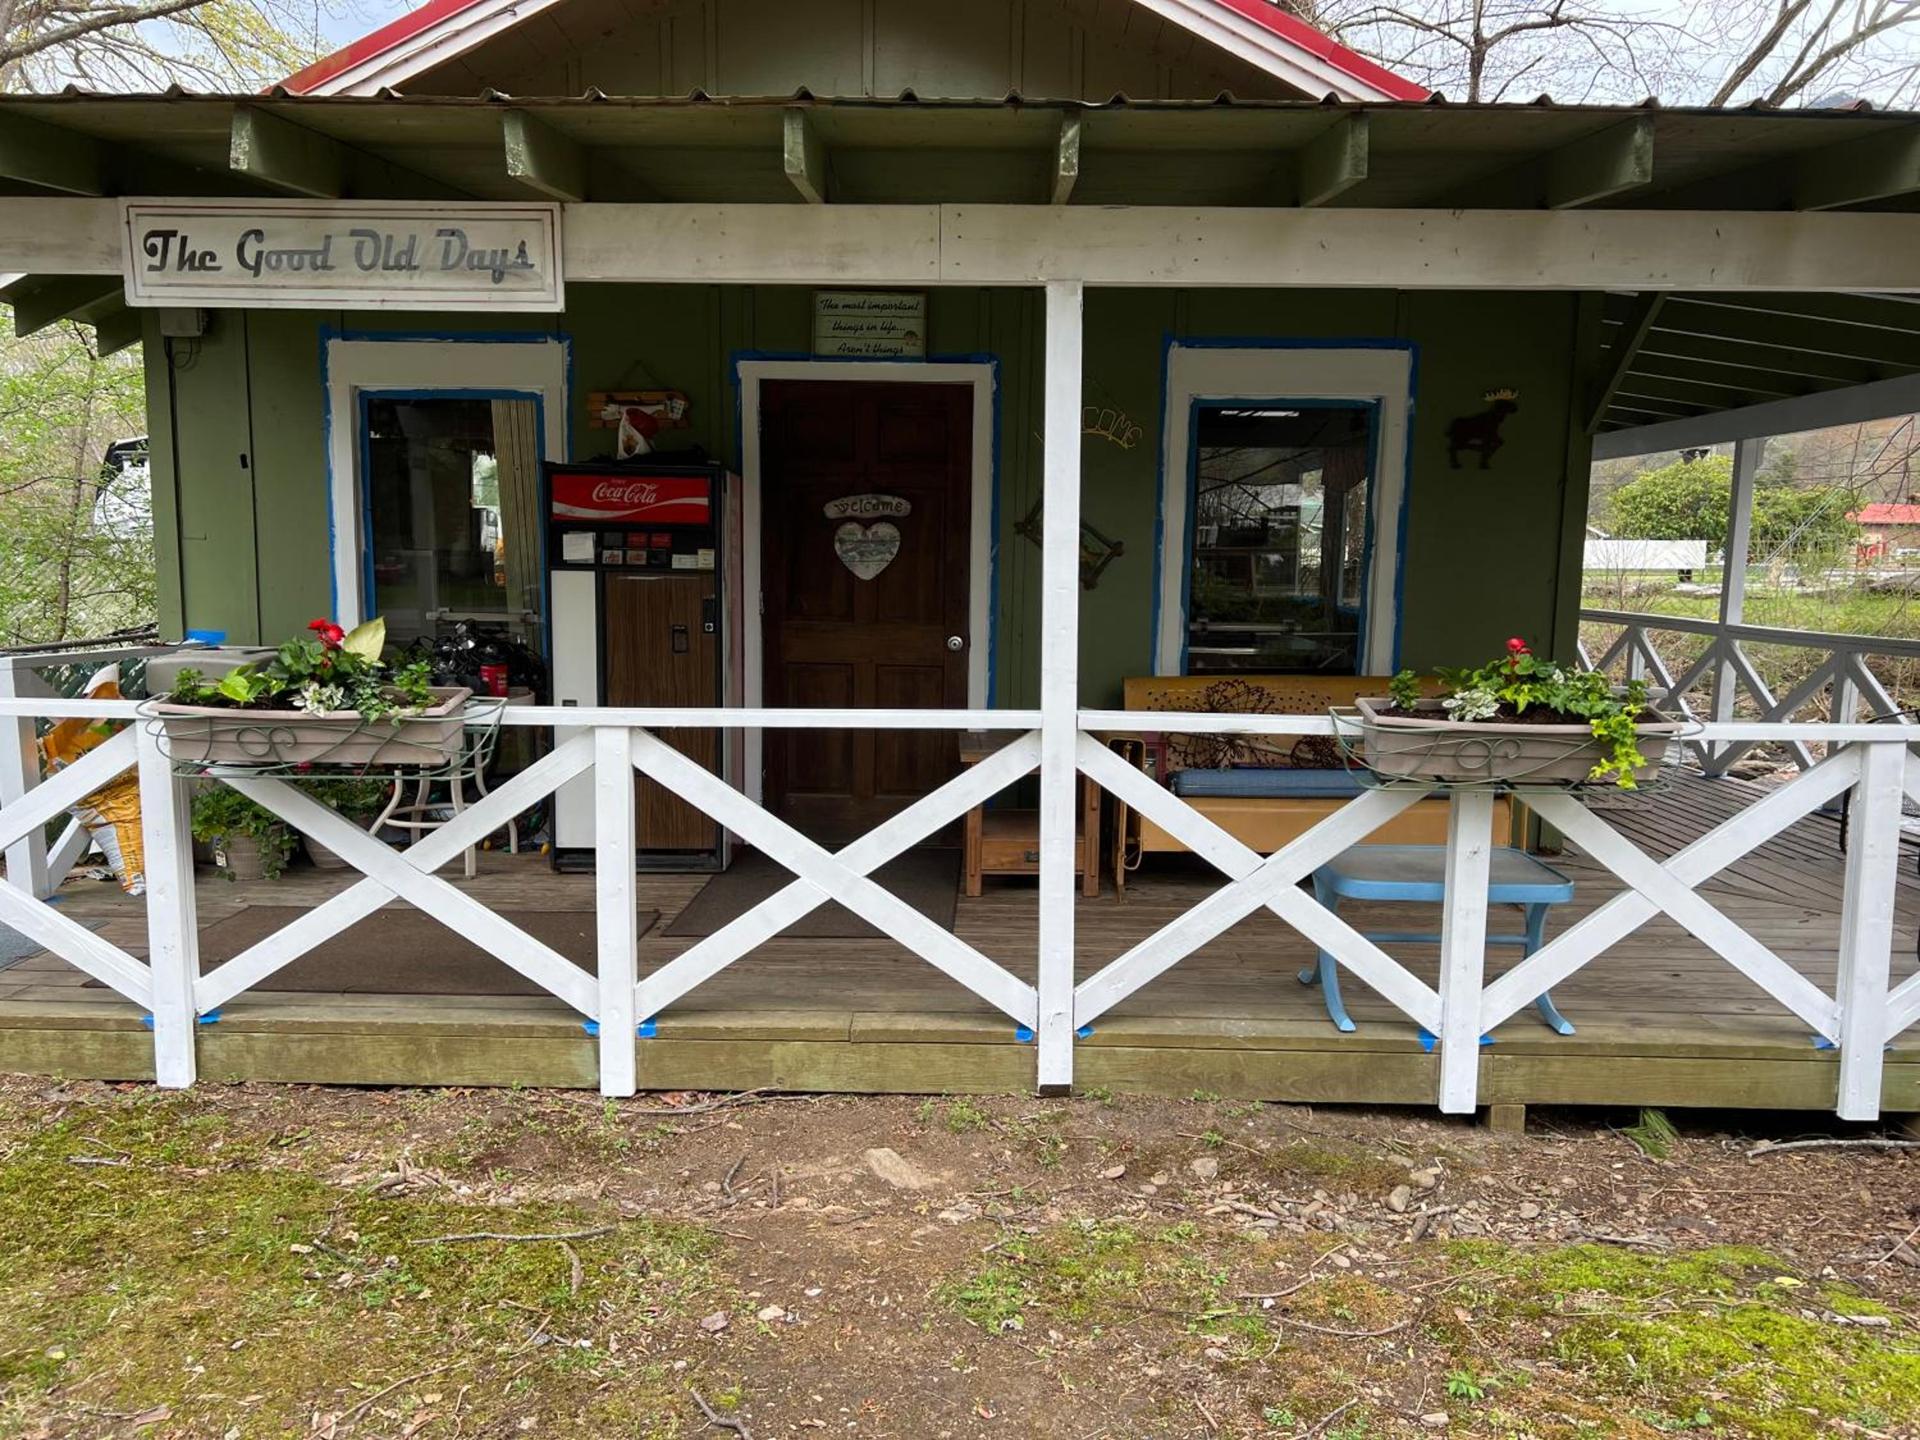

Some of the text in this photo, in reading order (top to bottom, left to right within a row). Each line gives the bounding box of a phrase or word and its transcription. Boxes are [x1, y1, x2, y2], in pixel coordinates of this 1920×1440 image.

[143, 229, 535, 284] The Good Old Days
[820, 299, 920, 313] The most important
[832, 320, 864, 335] things
[866, 322, 877, 331] in
[837, 342, 904, 356] Aren't things
[592, 482, 660, 504] Coca-Cola
